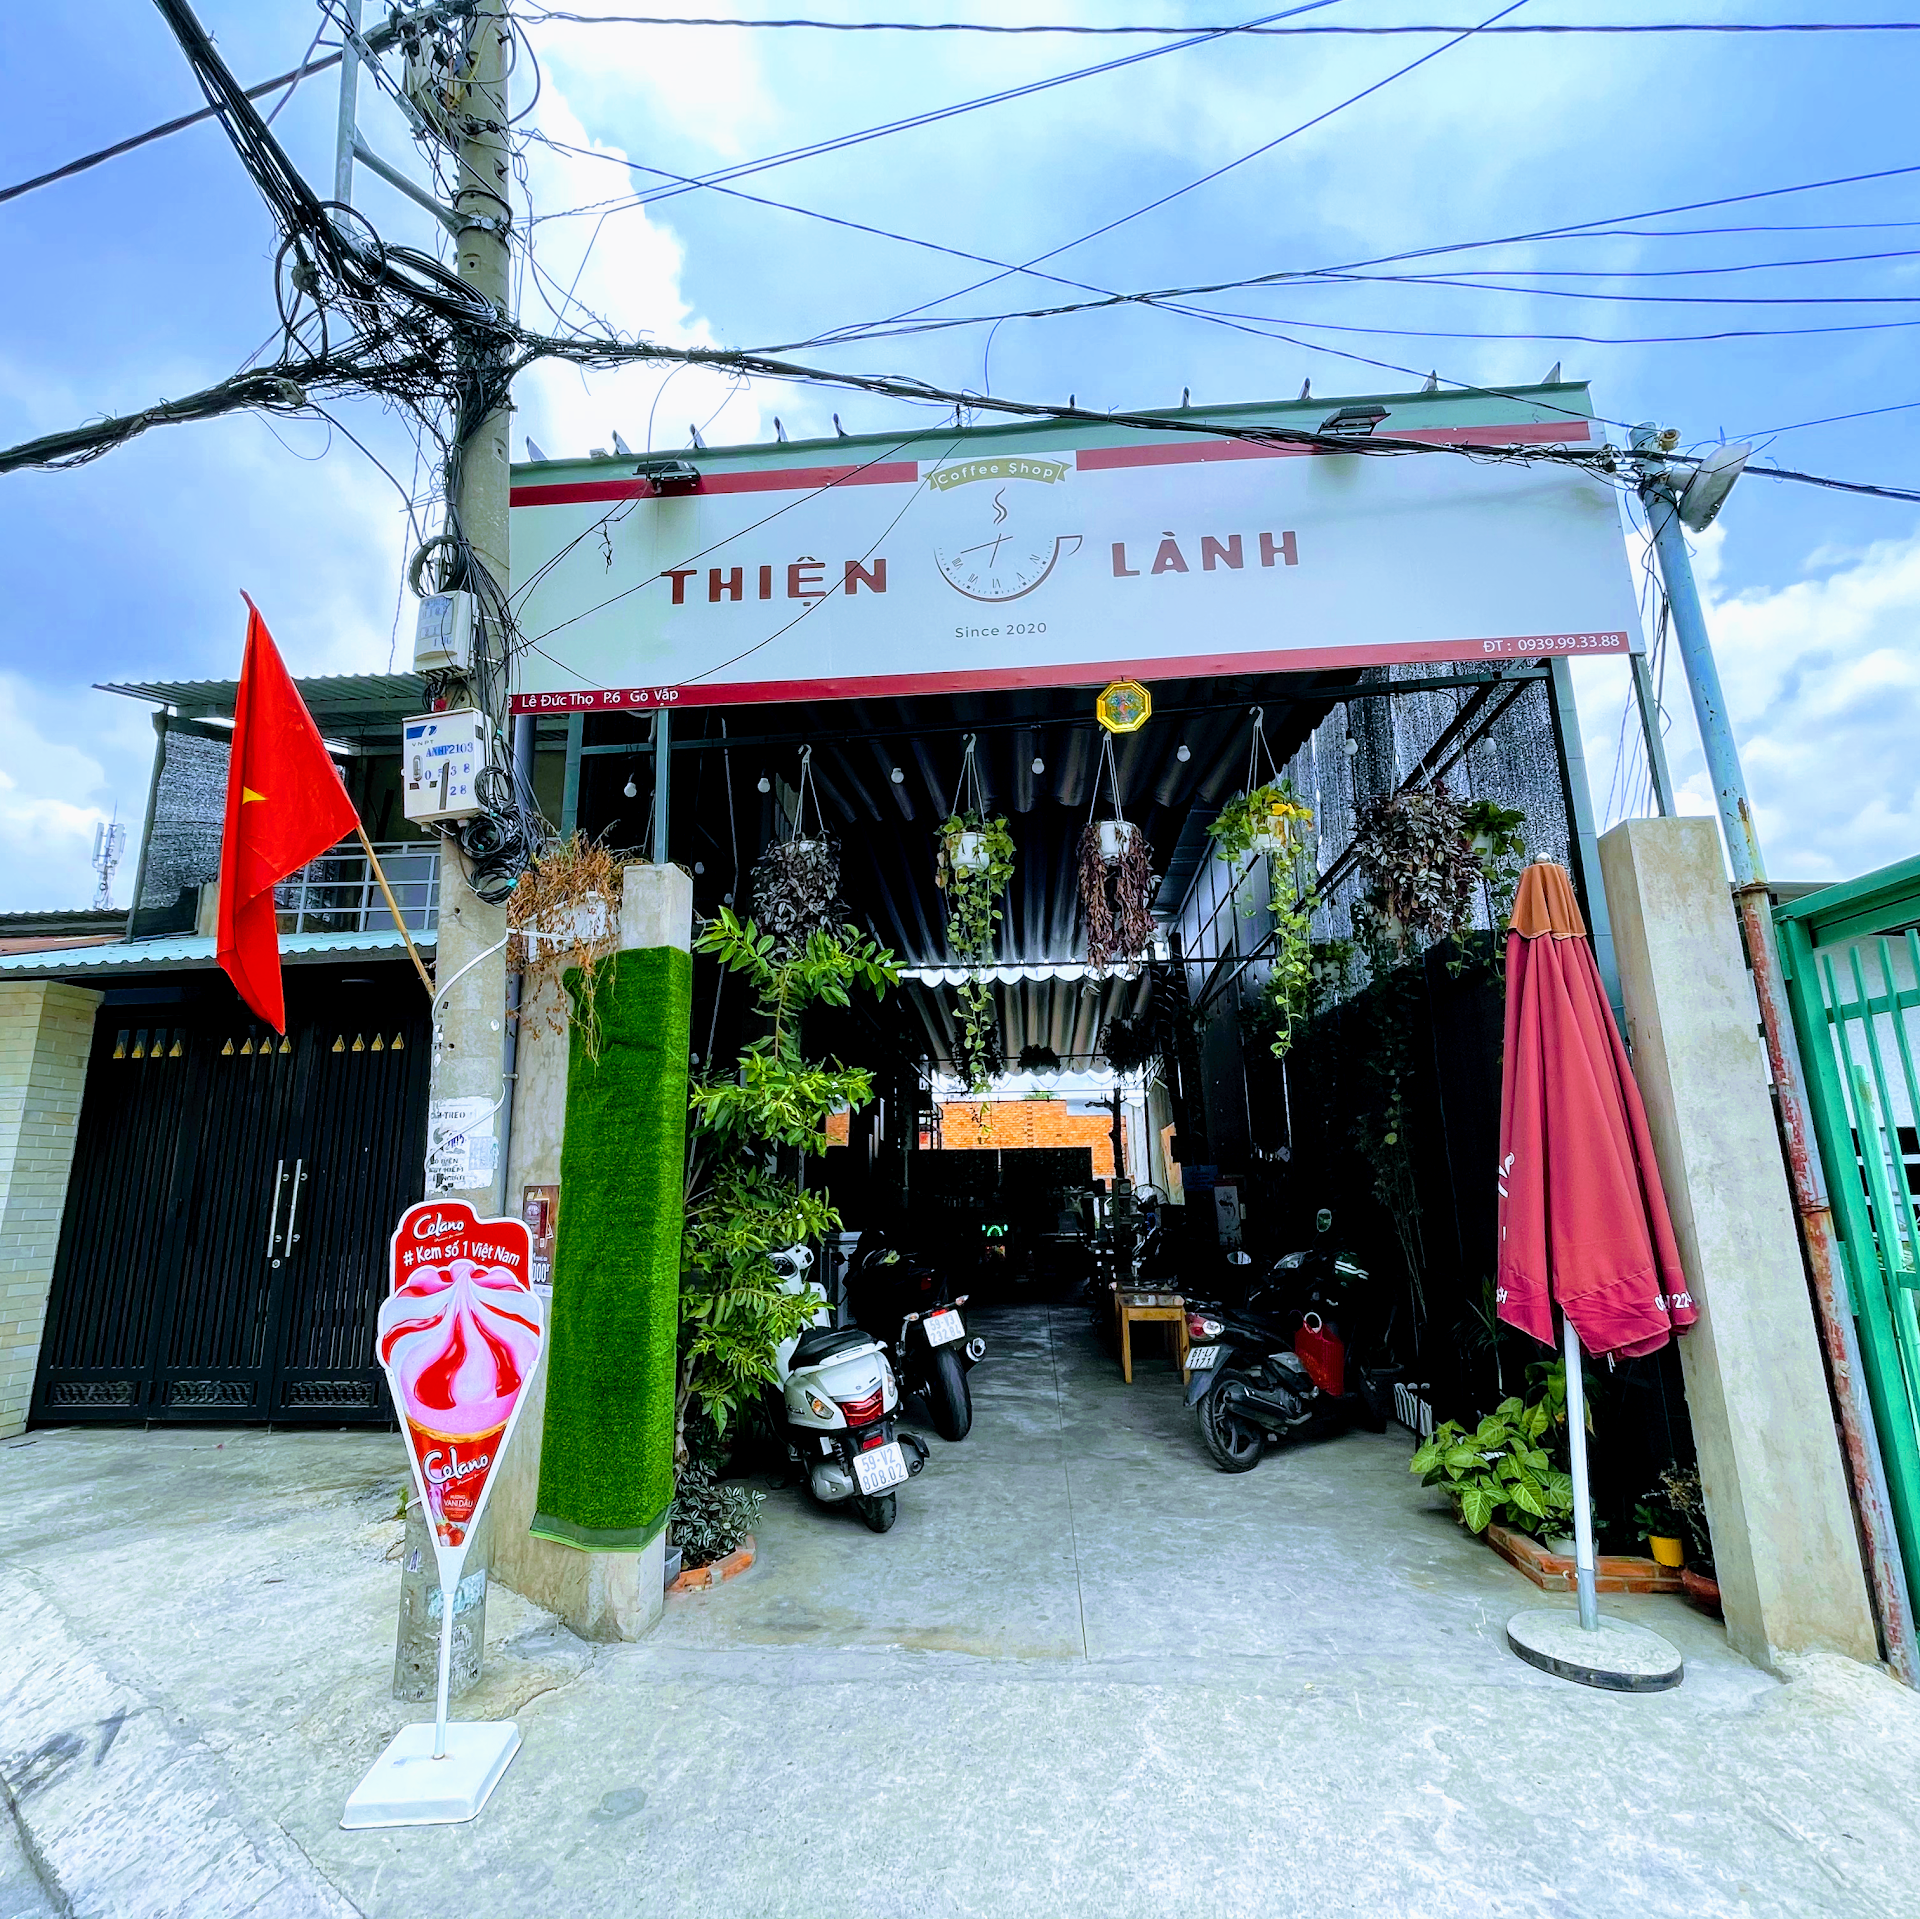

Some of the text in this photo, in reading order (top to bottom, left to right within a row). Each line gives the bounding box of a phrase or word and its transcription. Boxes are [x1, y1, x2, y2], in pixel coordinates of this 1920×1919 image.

[937, 462, 1053, 484] Coffee Shop
[660, 531, 1299, 606] THIỆN LÀNH
[955, 622, 1047, 638] Since 2020
[1483, 640, 1503, 653] ĐT
[1518, 634, 1620, 651] 0939.99.33.88
[521, 694, 537, 708] Lê
[540, 694, 567, 707] Đức
[569, 692, 594, 706] Thọ
[411, 739, 434, 747] VNPT
[413, 1212, 465, 1240] Celano
[416, 1246, 442, 1263] Kem
[444, 1240, 460, 1258] số
[462, 1240, 469, 1257] 1
[471, 1241, 494, 1261] Việt
[493, 1245, 520, 1266] Nam
[423, 1445, 489, 1484] Celano
[862, 1448, 896, 1472] 59-V2
[862, 1463, 905, 1491] 808.02
